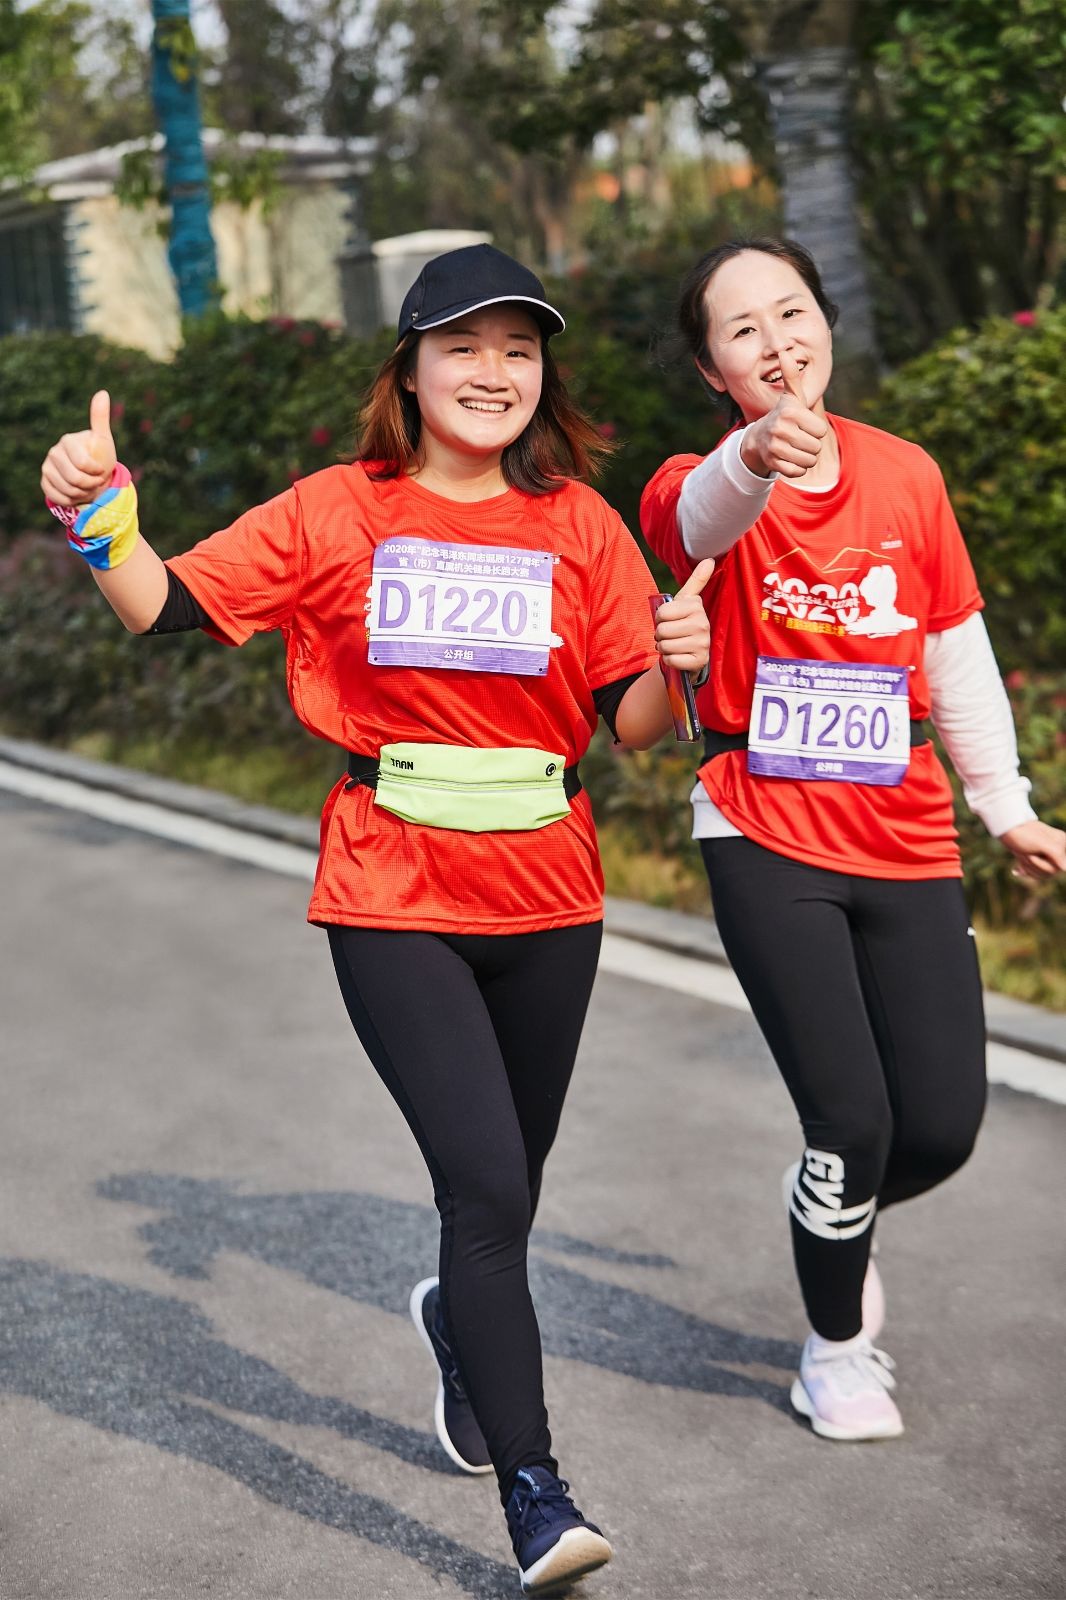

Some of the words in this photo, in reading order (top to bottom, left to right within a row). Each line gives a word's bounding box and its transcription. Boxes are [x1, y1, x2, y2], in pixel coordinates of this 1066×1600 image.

[378, 579, 528, 637] D1220
[761, 572, 860, 625] 2020
[443, 649, 474, 661] 公开组
[758, 695, 890, 751] D1260
